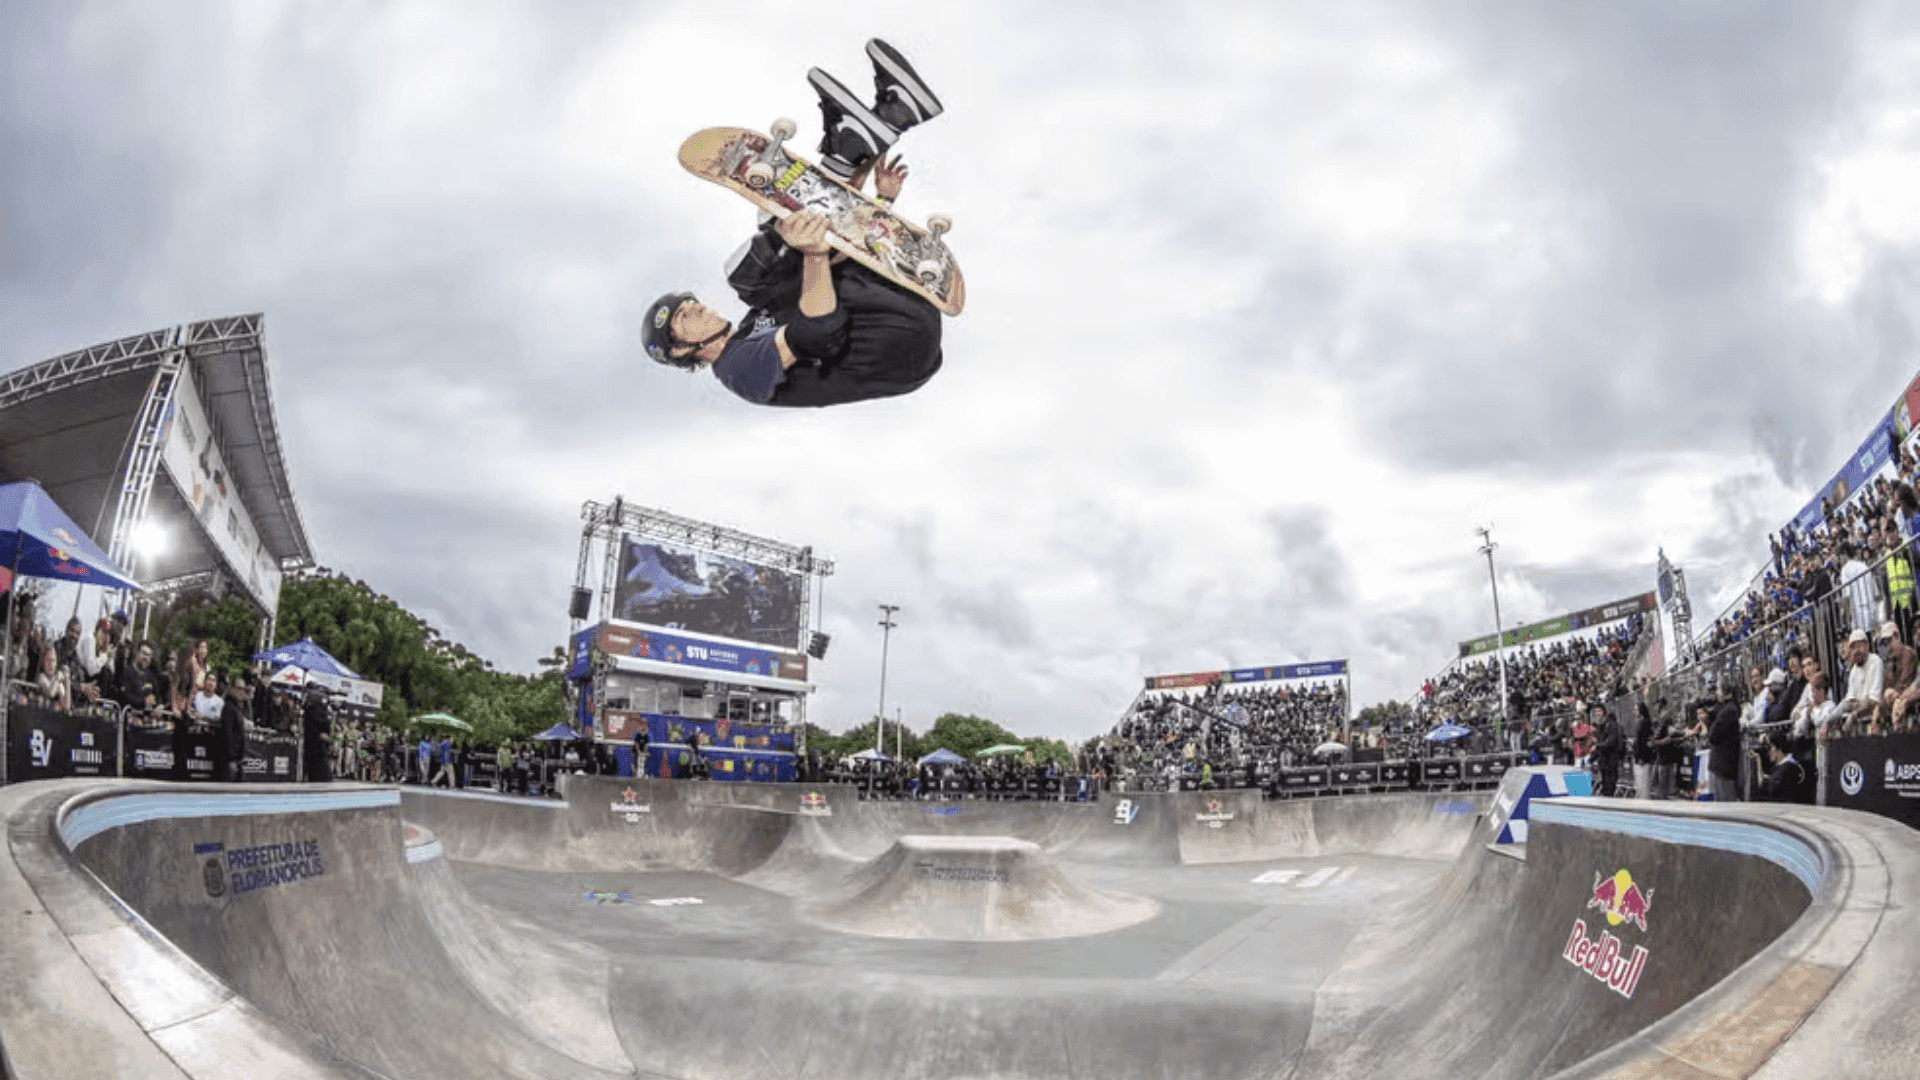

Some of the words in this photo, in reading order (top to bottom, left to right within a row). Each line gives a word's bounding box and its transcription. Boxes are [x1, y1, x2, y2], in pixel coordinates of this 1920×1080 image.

[686, 645, 708, 661] STU
[228, 841, 303, 870] PREFEITURA
[304, 838, 320, 859] DE
